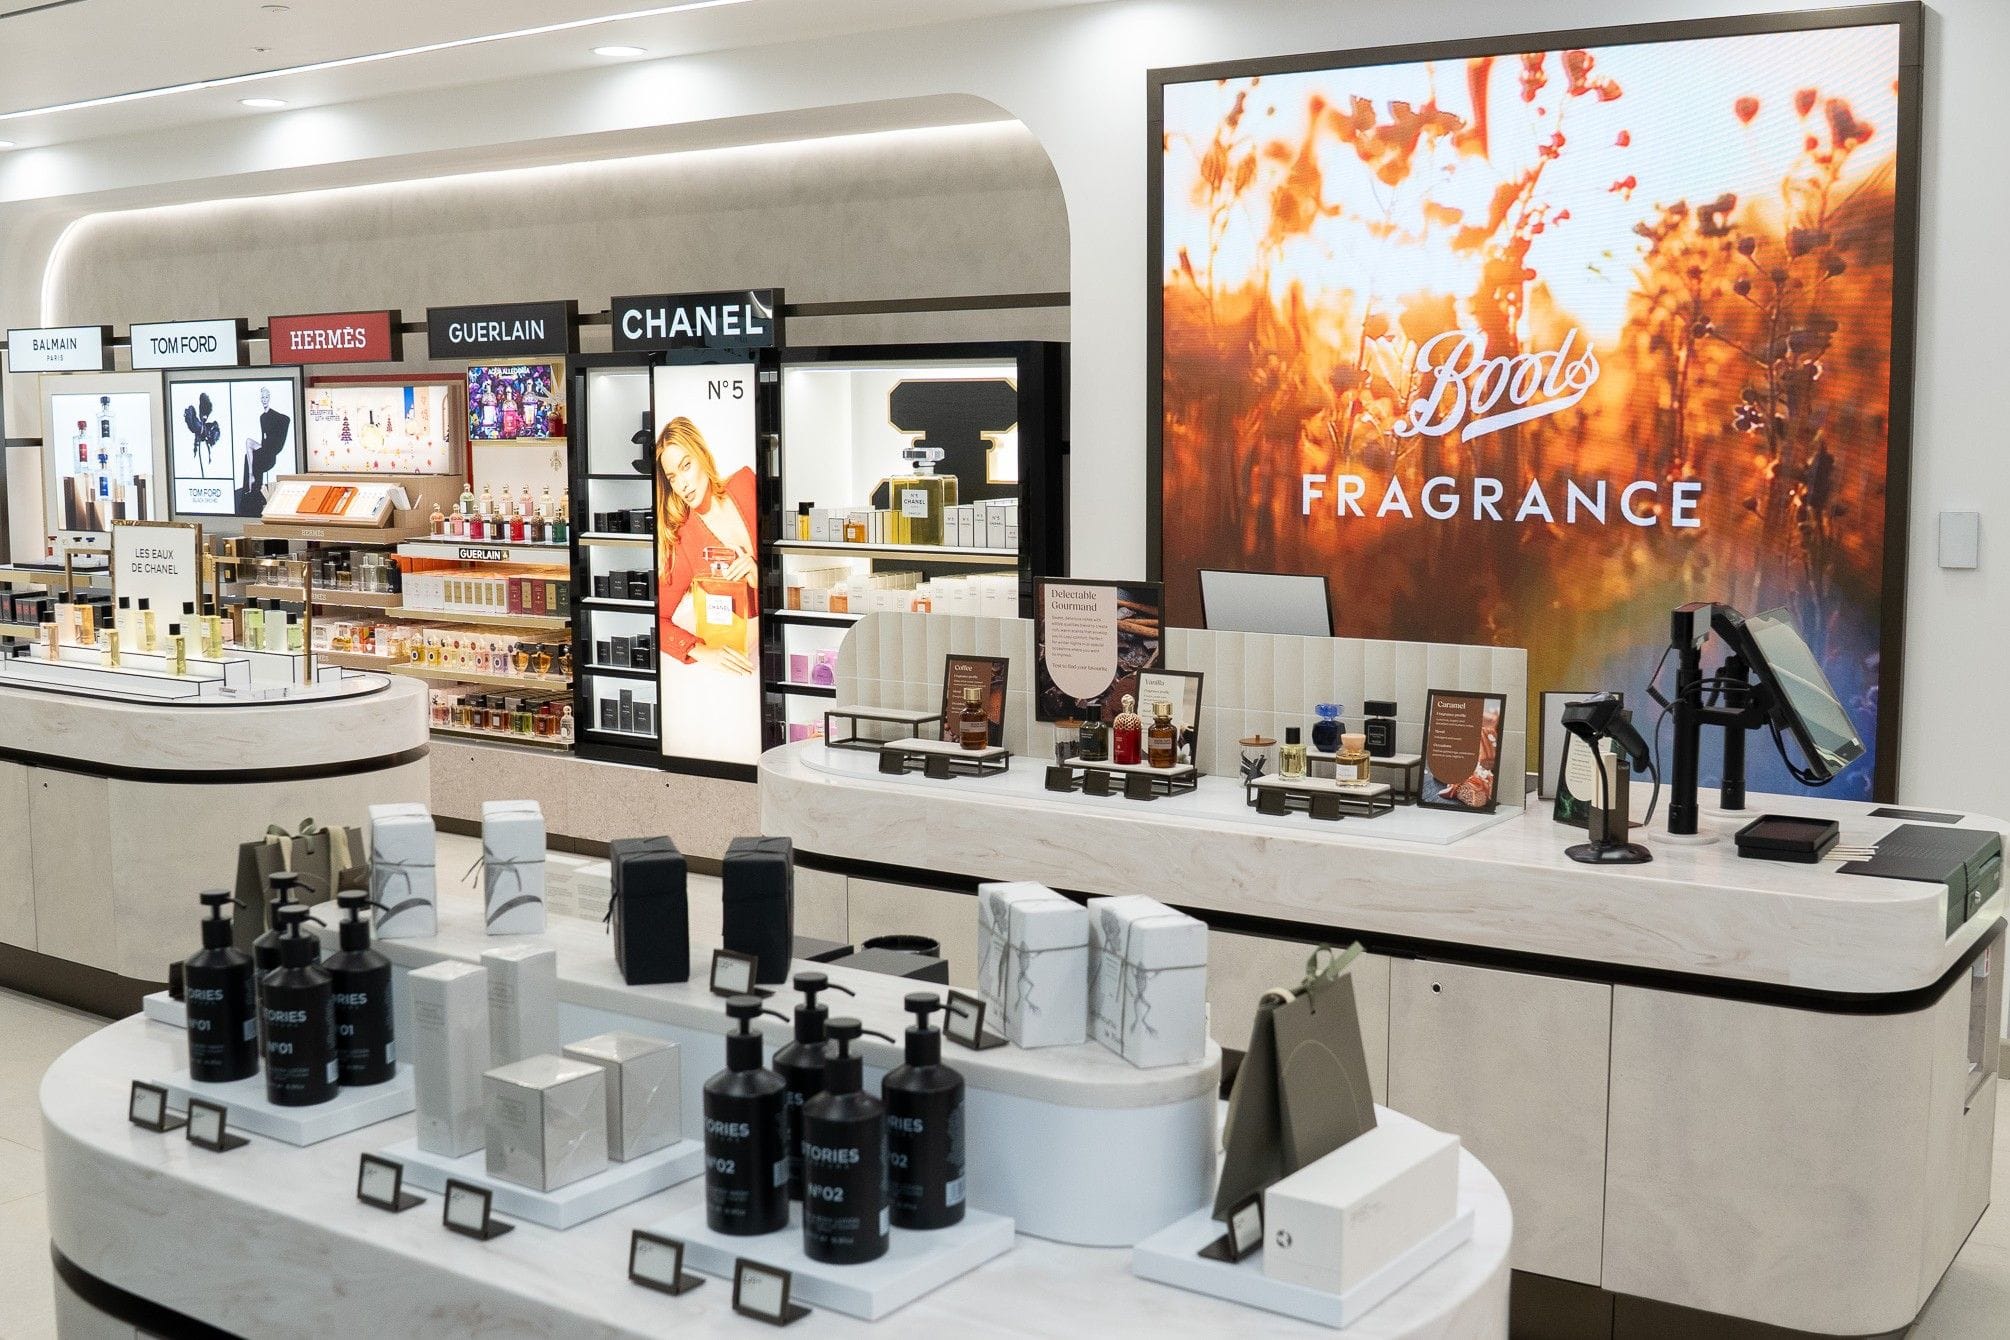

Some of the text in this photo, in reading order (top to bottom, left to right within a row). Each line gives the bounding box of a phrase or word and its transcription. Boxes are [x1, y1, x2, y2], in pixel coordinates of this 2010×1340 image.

[622, 304, 764, 339] CHANEL
[448, 319, 545, 343] GUERLAIN
[290, 326, 366, 350] HERMÈS
[32, 338, 77, 351] BALMAIN
[150, 335, 217, 355] TOM FORD
[1394, 328, 1600, 443] Boots
[203, 488, 222, 498] FORD
[1301, 473, 1702, 528] FRAGRANCE
[135, 549, 174, 560] LES EAUX
[460, 549, 501, 560] GUERLAIN
[131, 562, 178, 575] DE CHANEL
[1051, 589, 1097, 600] Delectable
[1051, 600, 1097, 611] Gourmand
[954, 664, 973, 672] Coffee
[1145, 678, 1165, 686] Vanilla
[1437, 700, 1466, 709] Caramel
